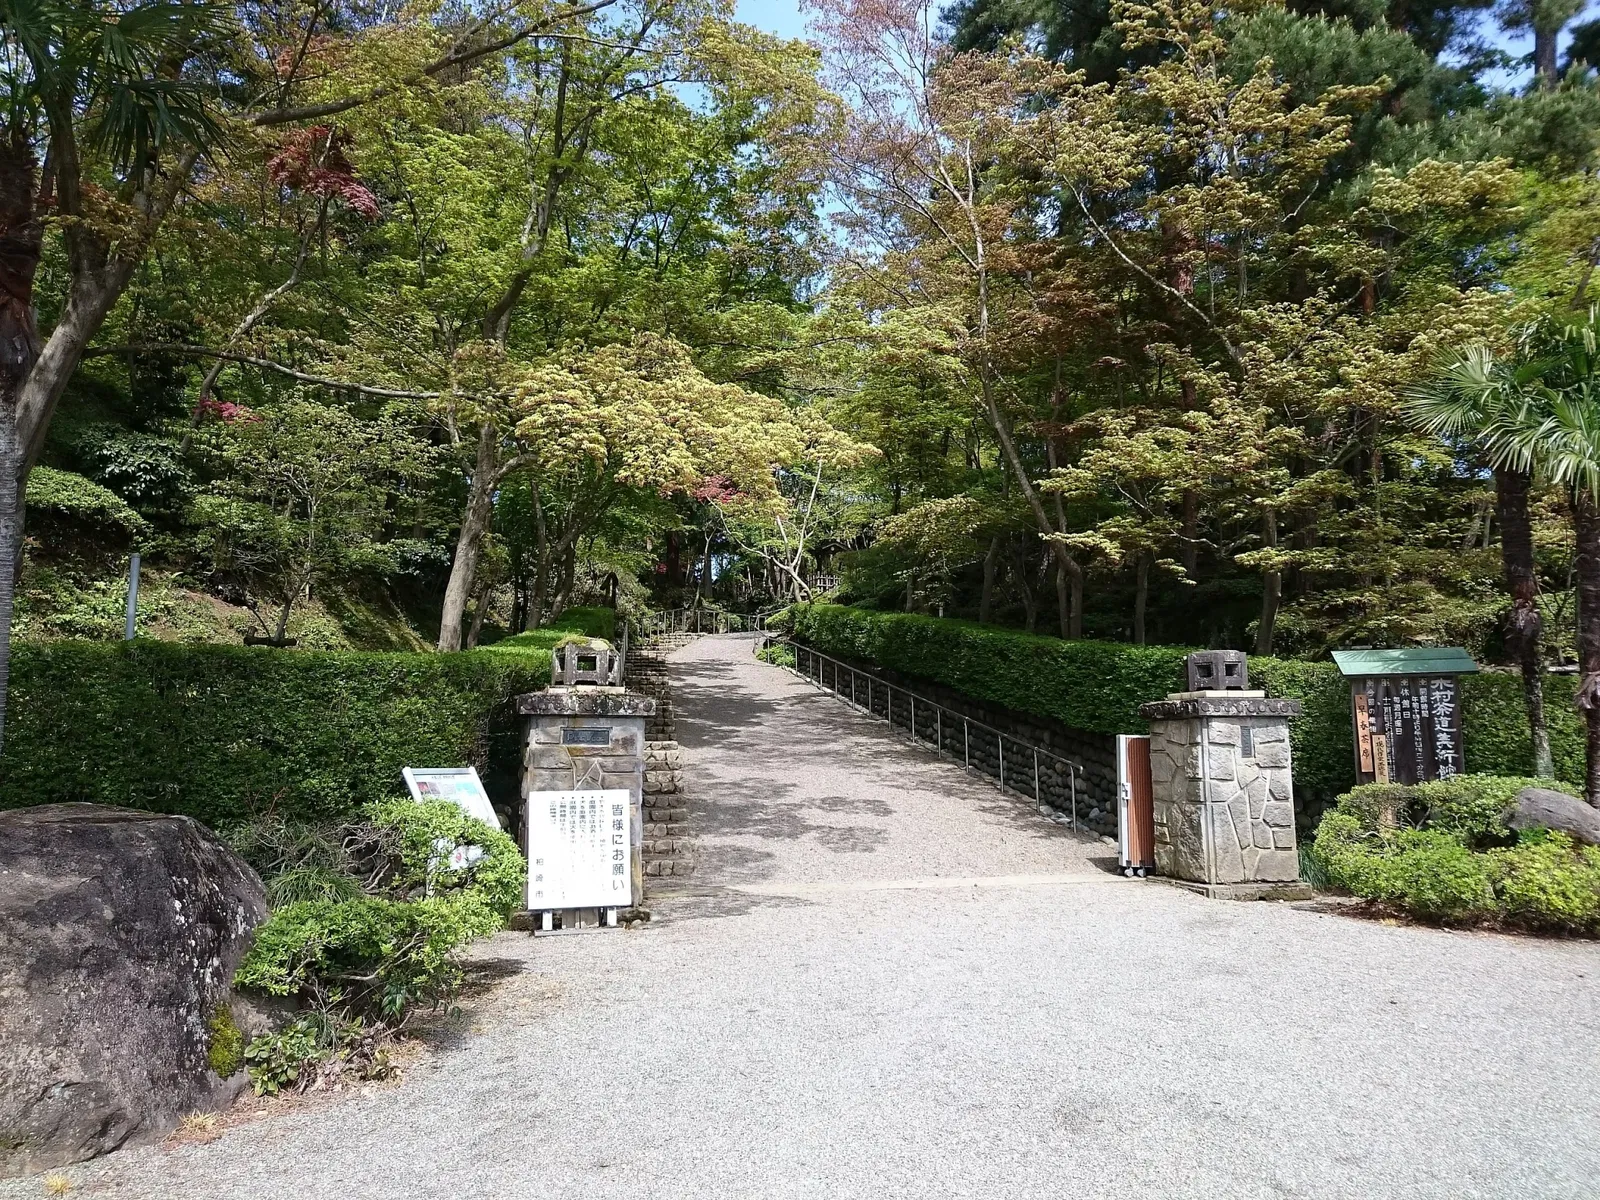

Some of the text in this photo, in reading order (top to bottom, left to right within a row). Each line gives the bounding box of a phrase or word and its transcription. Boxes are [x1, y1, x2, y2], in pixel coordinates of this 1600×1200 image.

[1400, 688, 1410, 718] 休館日
[612, 804, 624, 890] 皆様にお願い
